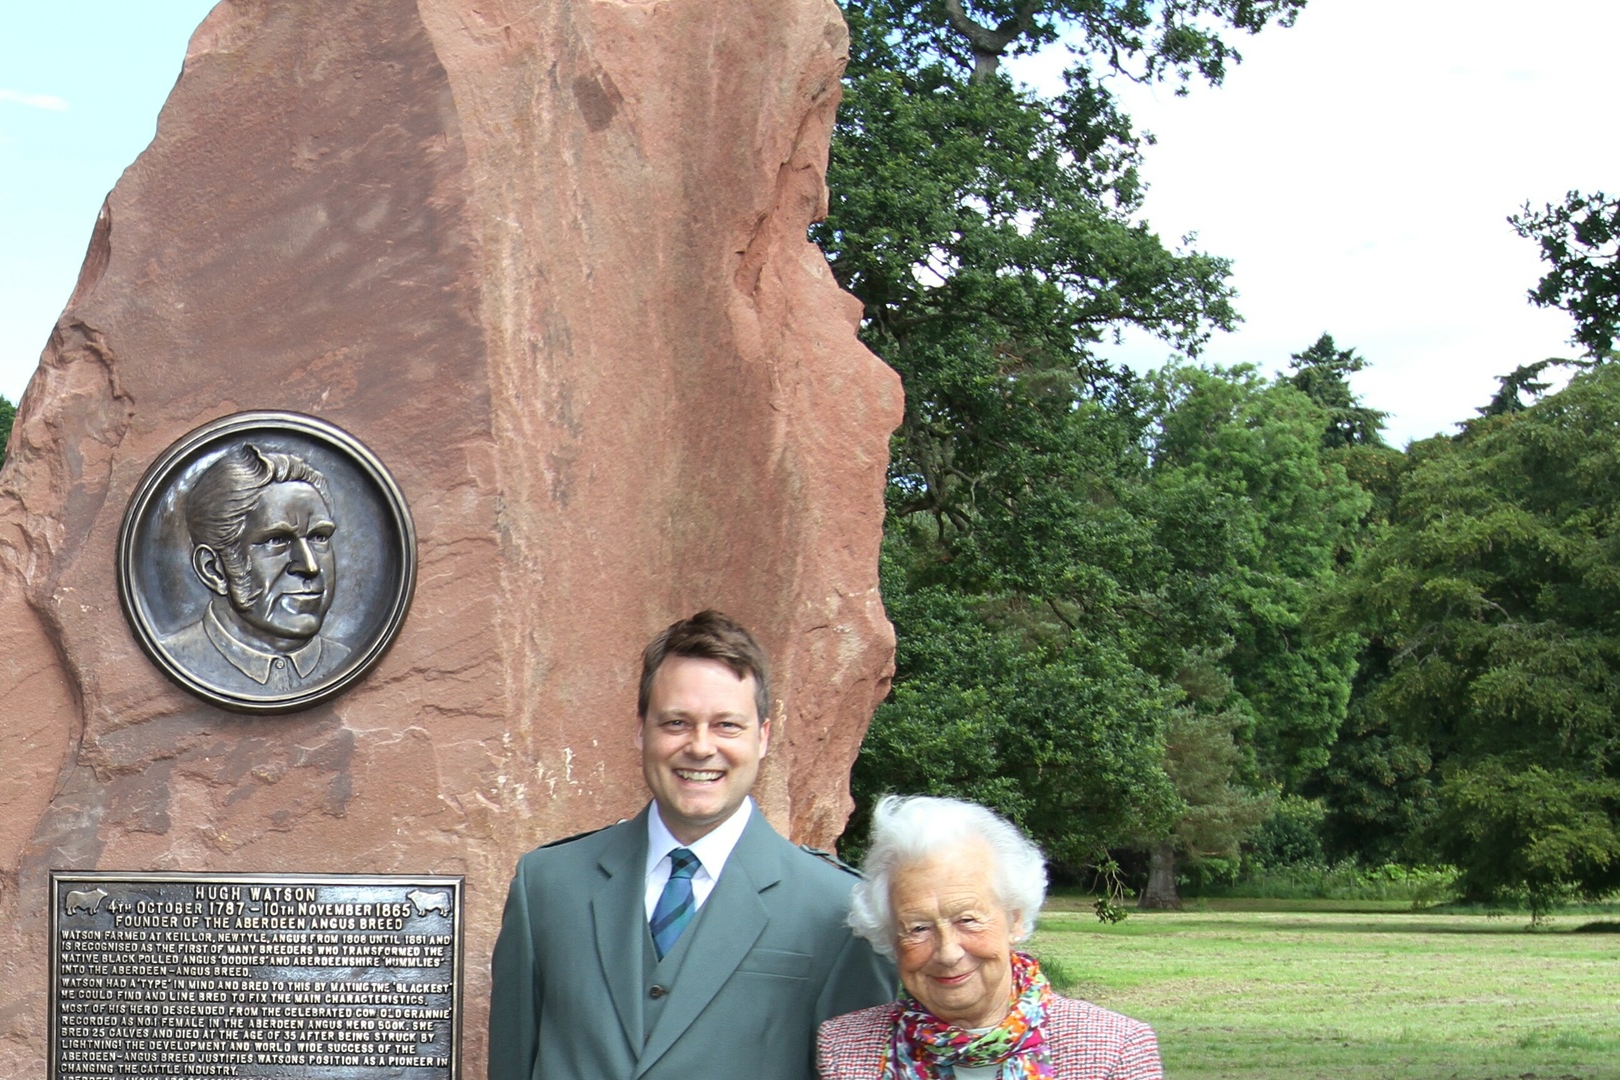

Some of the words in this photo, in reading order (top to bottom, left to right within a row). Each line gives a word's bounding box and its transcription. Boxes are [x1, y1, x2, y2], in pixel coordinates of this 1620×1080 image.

[196, 886, 240, 900] HUGH
[250, 888, 316, 901] WATSON
[137, 902, 202, 914] OCTOBER
[209, 902, 244, 915] 1787
[264, 902, 294, 916] 10TH
[298, 903, 372, 916] NOVEMBER
[376, 904, 410, 917] 1865
[116, 916, 178, 928] FOUNDER
[183, 918, 198, 928] OF
[204, 918, 230, 928] THE
[235, 918, 305, 929] ABERDEEN
[311, 918, 355, 930] ANGUS
[360, 919, 402, 930] BREED
[62, 930, 100, 940] WATSON
[104, 931, 146, 941] FARMED
[149, 932, 162, 941] AT
[272, 933, 306, 943] ANGUS
[310, 934, 338, 943] FROM
[369, 935, 400, 944] UNTIL
[429, 935, 450, 945] AND
[62, 942, 72, 952] IS
[74, 942, 138, 952] RECOGNISED
[140, 943, 153, 953] AS
[156, 944, 175, 953] THE
[178, 944, 208, 953] FIRST
[210, 944, 223, 954] OF
[227, 944, 256, 954] MANY
[260, 945, 313, 955] BREEDERS
[318, 946, 338, 955] WHO
[342, 946, 420, 956] TRANSFORMED
[424, 947, 443, 956] THE
[62, 954, 99, 964] NATIVE
[102, 954, 135, 964] BLACK
[138, 955, 178, 964] POLLED
[182, 955, 216, 965] ANGUS
[270, 956, 290, 965] AND
[293, 956, 380, 966] ABERDEENSHIRE
[62, 966, 84, 975] INTO
[88, 966, 108, 975] THE
[214, 967, 252, 978] BREED.
[62, 978, 102, 988] WATSON
[106, 978, 126, 988] HAD
[173, 979, 184, 989] IN
[188, 979, 214, 989] MIND
[218, 980, 238, 990] AND
[242, 980, 269, 990] BRED
[272, 981, 284, 990] TO
[288, 981, 310, 991] THIS
[314, 981, 326, 991] BY
[330, 981, 369, 992] MATING
[372, 982, 390, 992] THE
[62, 990, 75, 1000] HE
[78, 990, 112, 1000] COULD
[118, 991, 141, 1000] FIND
[145, 991, 166, 1001] AND
[169, 992, 194, 1001] LINE
[199, 992, 226, 1002] BRED
[232, 993, 244, 1002] TO
[248, 993, 267, 1002] FIX
[271, 993, 290, 1003] THE
[294, 994, 320, 1003] MAIN
[325, 994, 428, 1006] CHARACTERISTICS.
[62, 1004, 88, 1013] MOST
[92, 1004, 106, 1014] OF
[108, 1004, 126, 1014] HIS
[130, 1005, 158, 1014] HERD
[162, 1005, 225, 1015] DESCENDED
[228, 1006, 258, 1016] FROM
[262, 1007, 281, 1016] THE
[284, 1007, 352, 1017] CELEBRATED
[356, 1008, 376, 1018] COW
[62, 1016, 117, 1026] RECORDED
[120, 1016, 134, 1026] AS
[161, 1017, 204, 1027] FEMALE
[209, 1018, 220, 1027] IN
[224, 1018, 244, 1028] THE
[248, 1018, 304, 1029] ABERDEEN
[308, 1019, 342, 1029] ANGUS
[346, 1020, 374, 1030] HERD
[412, 1021, 434, 1031] SHE
[62, 1028, 88, 1037] BRED
[92, 1028, 105, 1038] 25
[108, 1028, 149, 1038] CALVES
[152, 1029, 172, 1039] AND
[176, 1029, 199, 1039] DIED
[202, 1030, 216, 1039] AT
[219, 1030, 238, 1040] THE
[242, 1030, 263, 1040] AGE
[267, 1031, 280, 1040] OF
[284, 1031, 296, 1040] 35
[299, 1031, 334, 1041] AFTER
[338, 1032, 370, 1041] BEING
[374, 1032, 416, 1042] STRUCK
[420, 1033, 435, 1042] BY
[62, 1040, 122, 1050] LIGHTNING!
[125, 1040, 145, 1050] THE
[149, 1041, 226, 1051] DEVELOPMENT
[229, 1042, 250, 1052] AND
[254, 1042, 290, 1052] WORLD
[296, 1043, 323, 1052] WIDE
[327, 1043, 374, 1053] SUCCESS
[378, 1044, 391, 1053] OF
[395, 1044, 416, 1054] THE
[161, 1053, 195, 1063] BREED
[198, 1053, 253, 1064] JUSTIFIES
[258, 1054, 305, 1064] WATSONS
[309, 1055, 359, 1065] POSITION
[363, 1056, 376, 1065] AS
[378, 1056, 385, 1065] A
[388, 1056, 434, 1066] PIONEER
[436, 1057, 448, 1066] IN
[62, 1064, 114, 1074] CHANGING
[118, 1064, 138, 1074] THE
[140, 1064, 180, 1074] CATTLE
